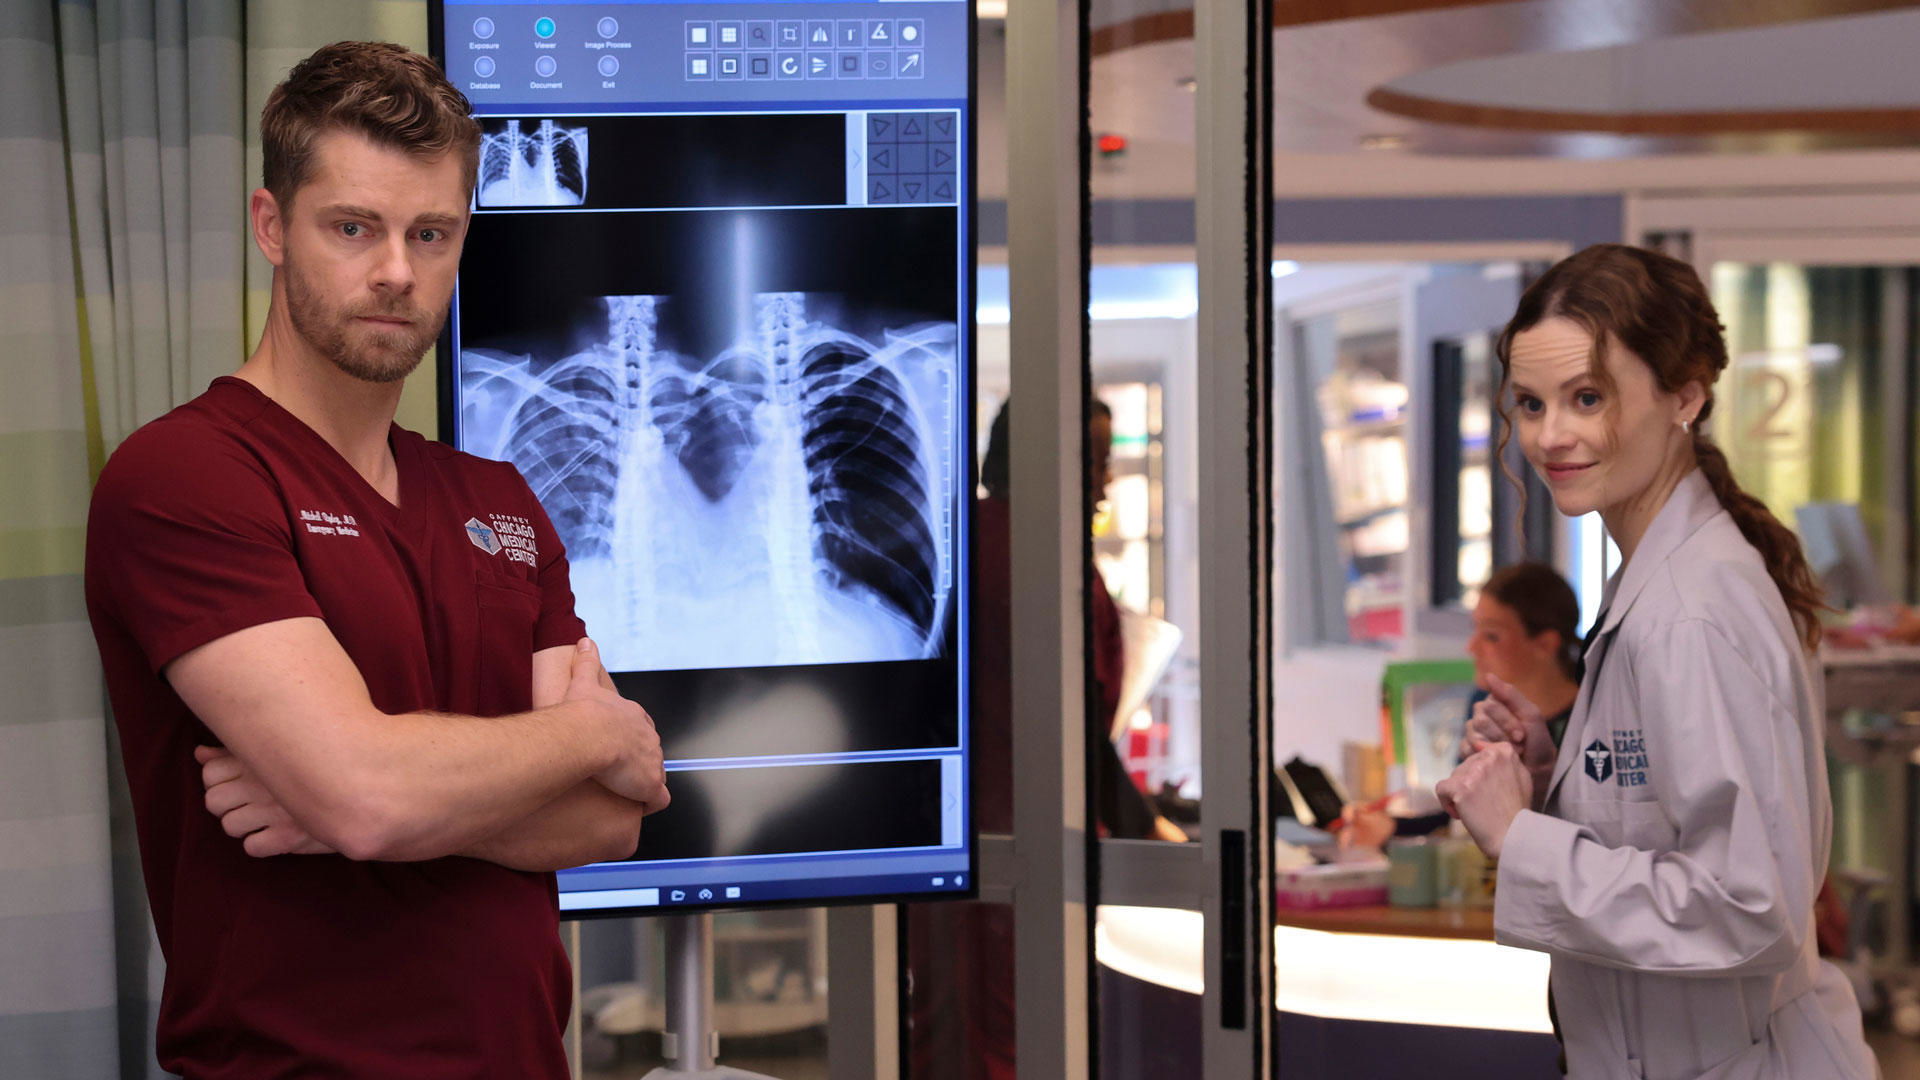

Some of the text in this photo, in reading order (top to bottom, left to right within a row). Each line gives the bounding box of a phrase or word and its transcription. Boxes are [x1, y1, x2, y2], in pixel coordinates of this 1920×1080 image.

[469, 42, 500, 50] Exposure
[584, 41, 632, 50] Image Process
[470, 82, 501, 90] Database
[530, 81, 563, 89] Document
[602, 81, 616, 89] Exit
[1748, 369, 1792, 438] 2
[489, 513, 529, 524] GAFFNEY
[493, 520, 535, 540] CHICAGO
[499, 533, 539, 555] MEDICAL
[505, 548, 537, 568] CENTER
